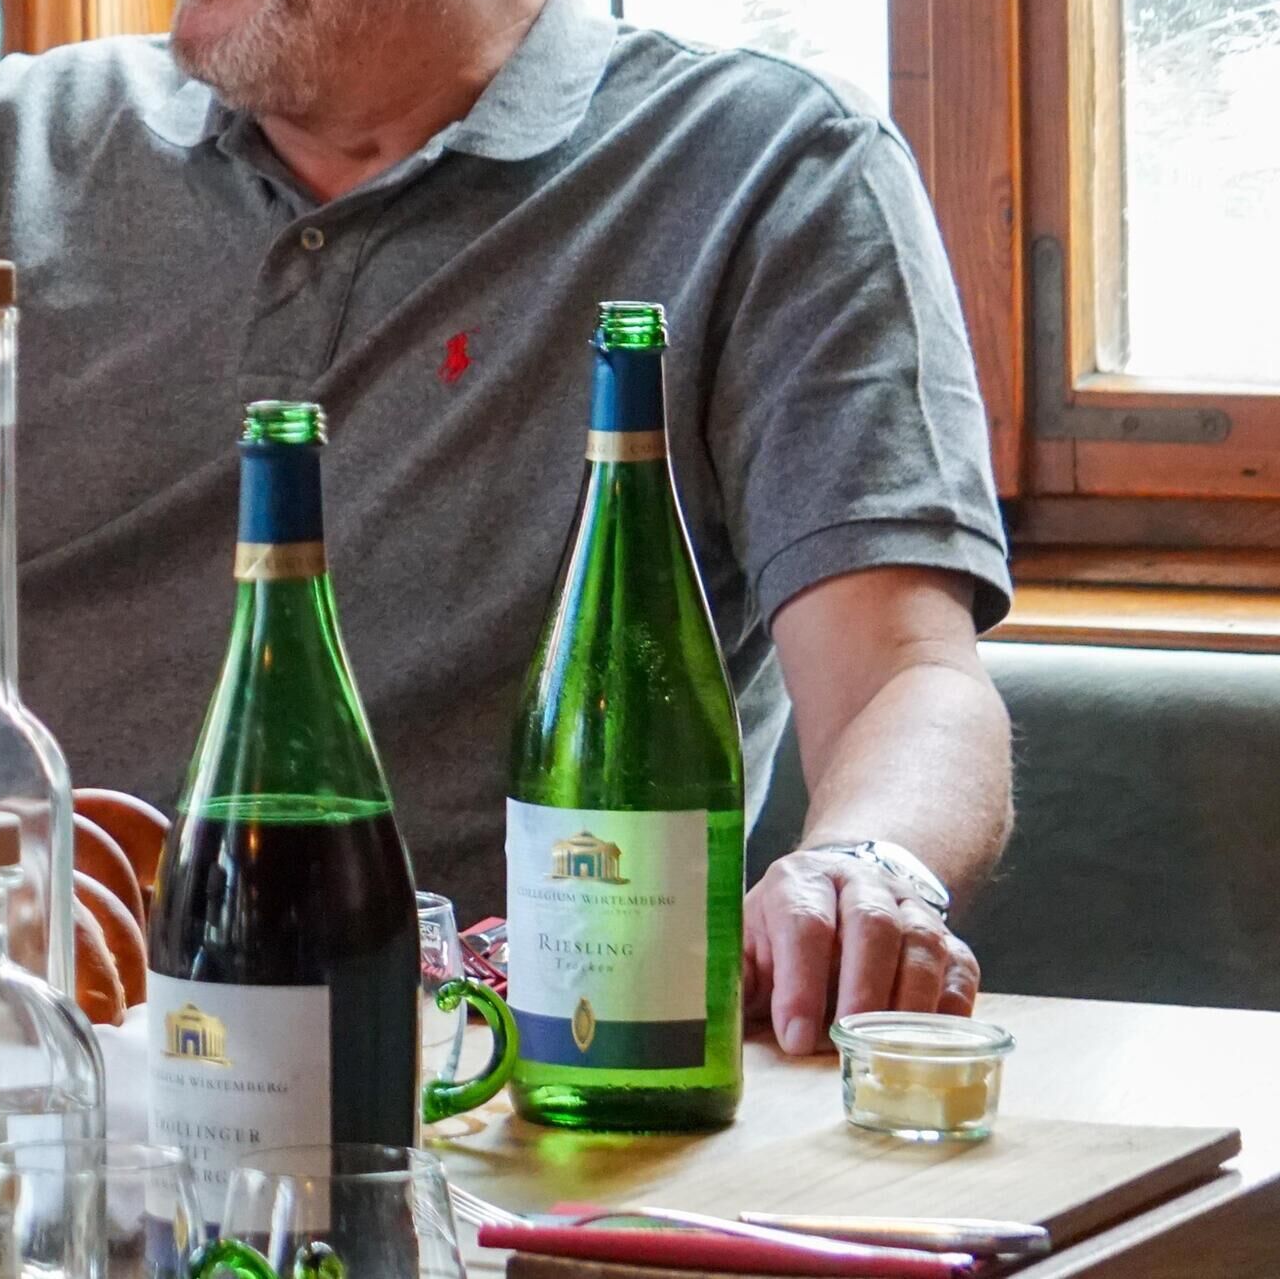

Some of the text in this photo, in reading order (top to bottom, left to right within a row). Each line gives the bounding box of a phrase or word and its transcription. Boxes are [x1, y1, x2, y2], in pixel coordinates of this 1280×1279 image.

[517, 887, 676, 906] COLLEGIUM WIRTEMBERG
[190, 1076, 289, 1094] WIRTEMBERG
